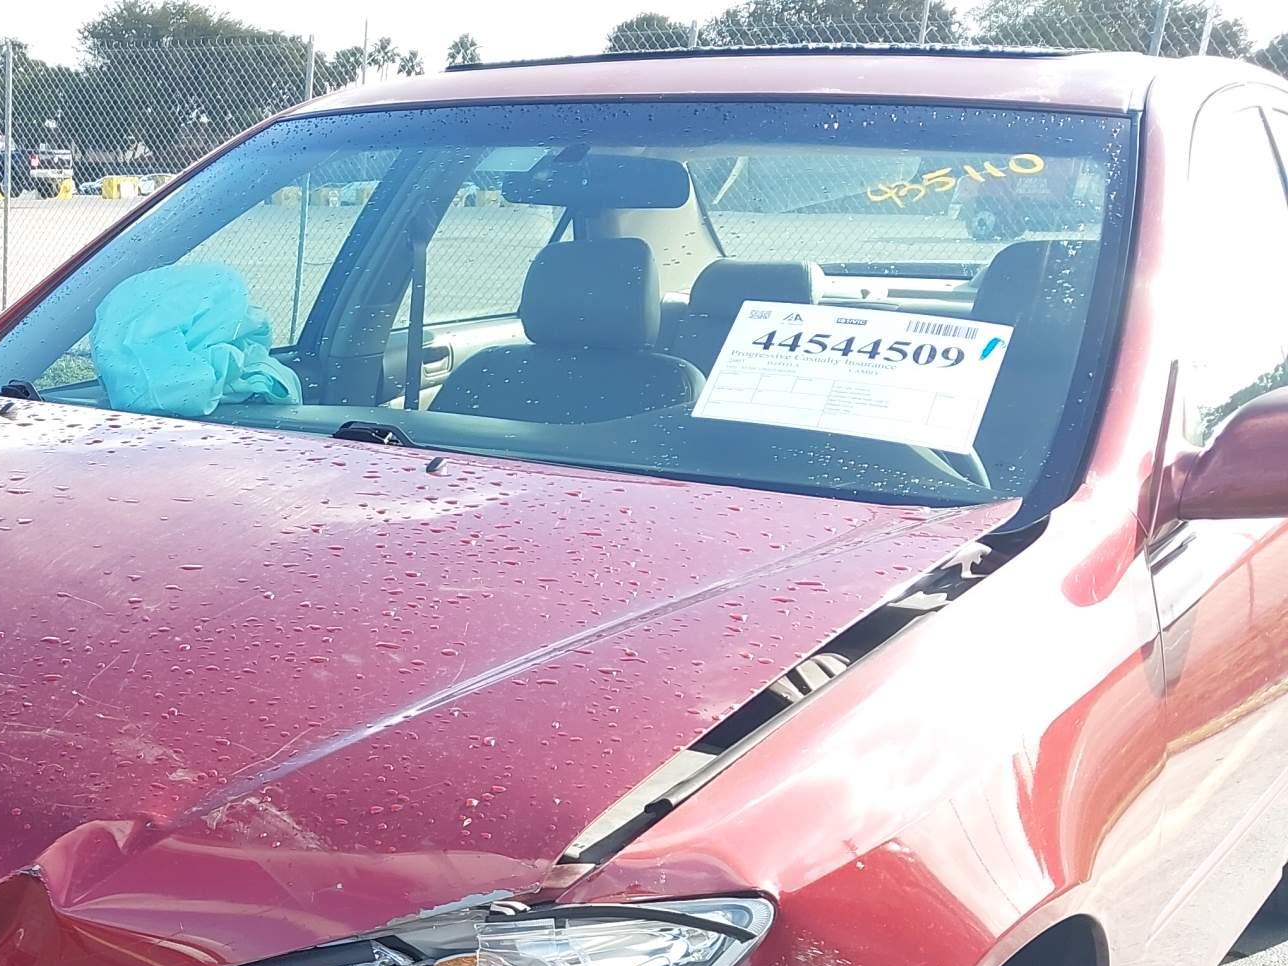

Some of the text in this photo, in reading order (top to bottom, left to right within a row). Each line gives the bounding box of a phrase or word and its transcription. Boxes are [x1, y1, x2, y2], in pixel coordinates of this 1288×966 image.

[731, 349, 793, 361] Progressive
[794, 353, 842, 366] Casualty
[844, 355, 897, 370] Insurance
[751, 329, 966, 369] 44544509
